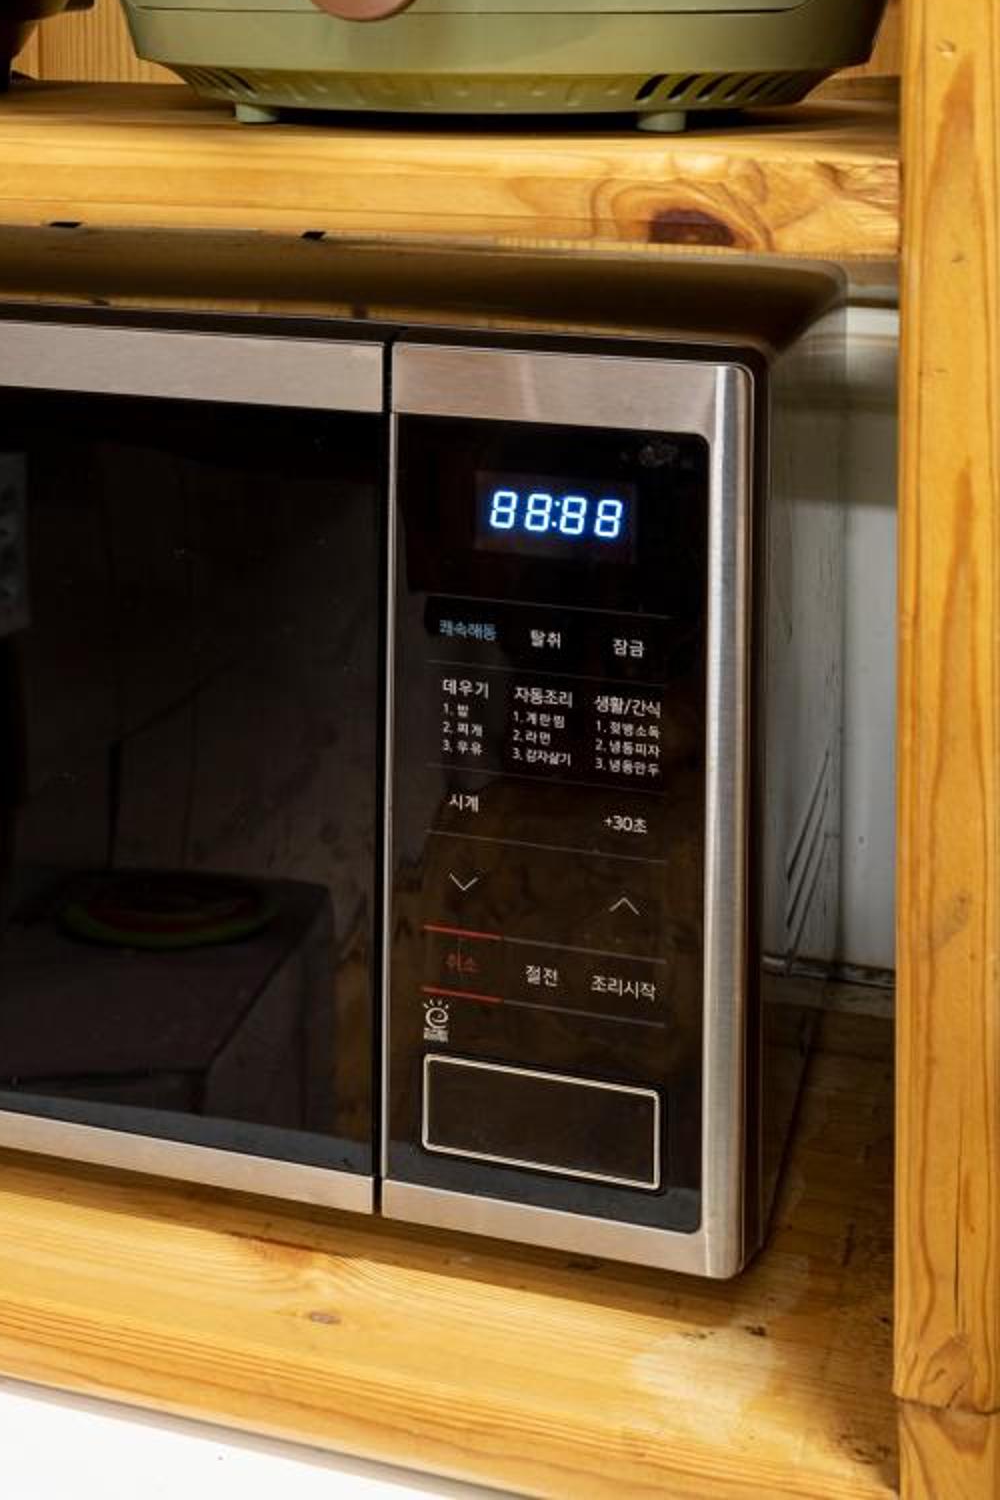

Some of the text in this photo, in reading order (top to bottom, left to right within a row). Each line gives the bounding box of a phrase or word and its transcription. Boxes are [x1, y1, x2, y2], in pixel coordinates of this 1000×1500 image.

[489, 491, 623, 537] 88:88
[530, 629, 562, 650] 탈취
[613, 638, 645, 658] 잠금
[442, 679, 489, 700] 데우기
[513, 686, 573, 708] 자동조리
[594, 695, 661, 718] 생활/간식
[525, 730, 551, 745] 라면
[457, 740, 483, 757] 우유
[449, 793, 480, 814] 시계
[604, 816, 648, 835] +30초
[525, 964, 559, 987] 절전
[590, 975, 656, 1001] 조리시작
